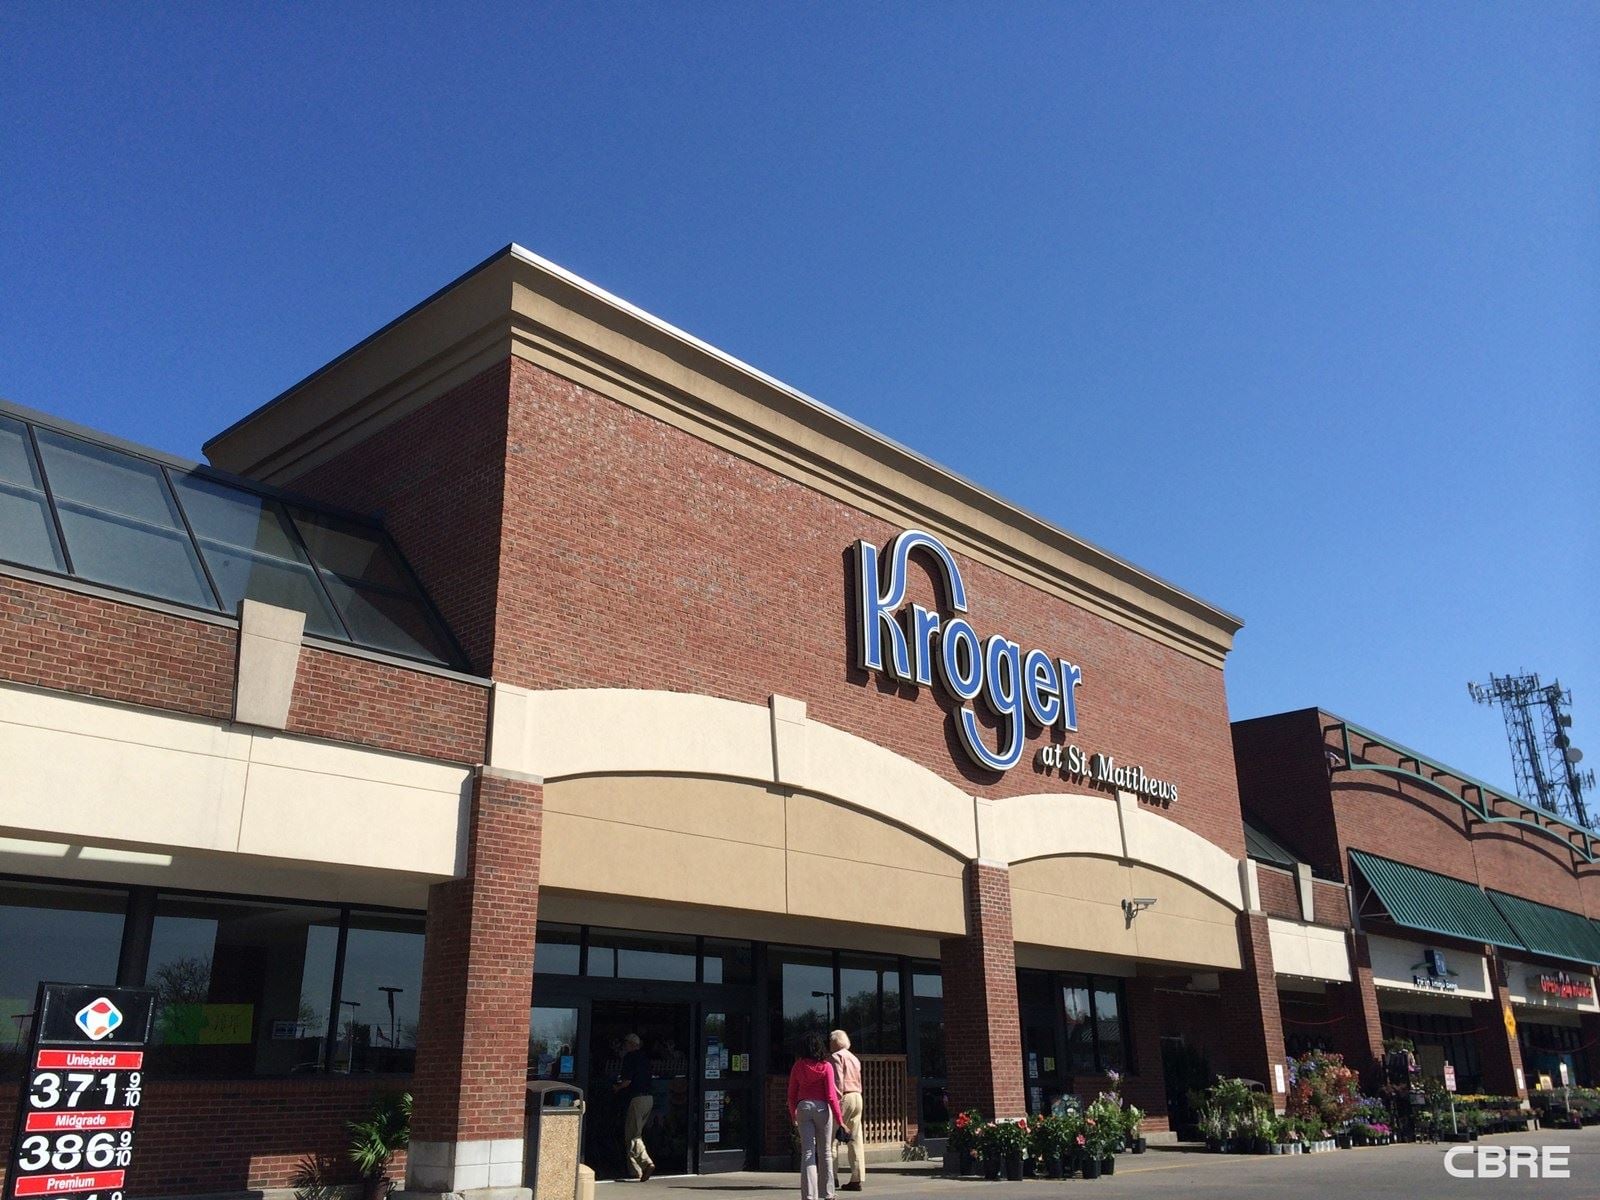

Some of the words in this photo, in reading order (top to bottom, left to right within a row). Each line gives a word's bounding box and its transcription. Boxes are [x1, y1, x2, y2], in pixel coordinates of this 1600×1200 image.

[855, 529, 1082, 772] Kroger
[1042, 743, 1063, 768] at
[1068, 744, 1093, 778] St.
[1097, 753, 1179, 803] Matthews
[66, 1053, 116, 1067] Unleaded
[29, 1072, 118, 1109] 371
[55, 1114, 107, 1128] Midgrade
[18, 1132, 115, 1171] 386
[46, 1175, 95, 1191] Premium
